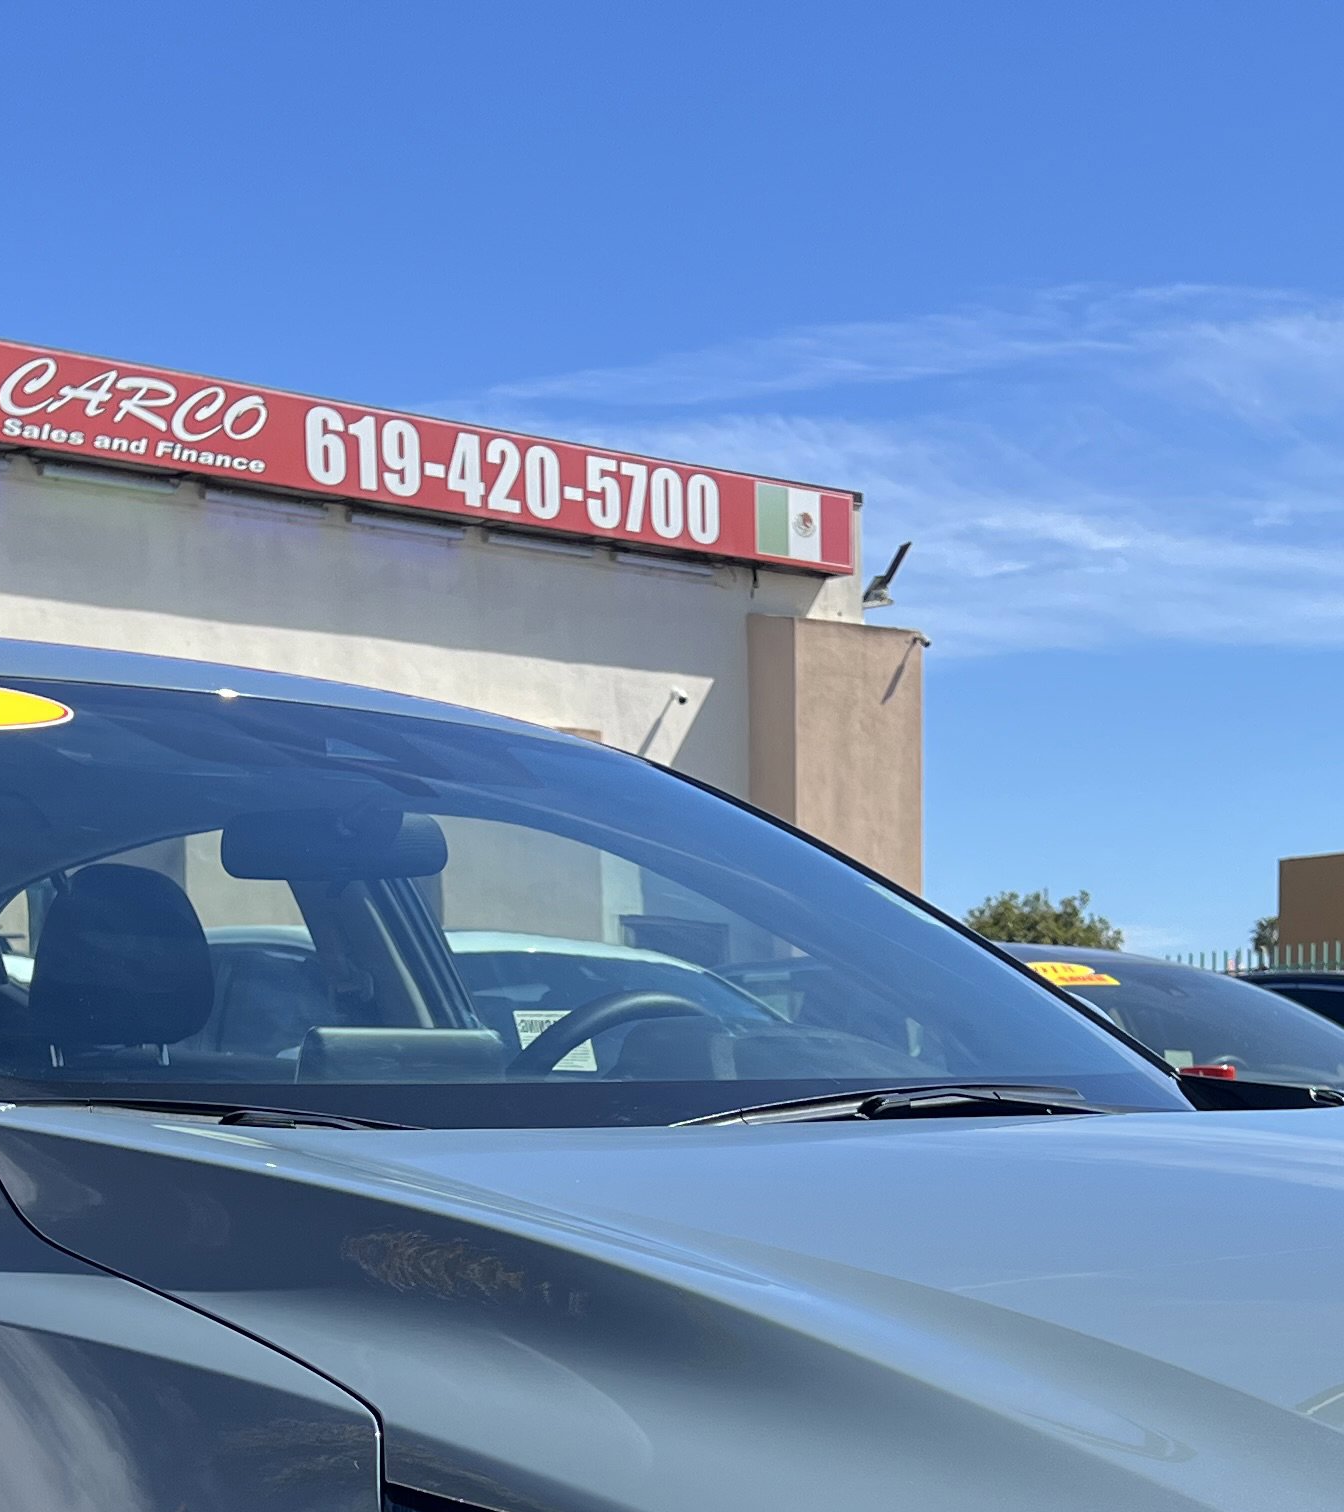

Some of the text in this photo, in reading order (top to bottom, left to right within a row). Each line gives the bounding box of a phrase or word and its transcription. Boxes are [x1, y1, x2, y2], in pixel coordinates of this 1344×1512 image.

[2, 418, 266, 473] Sales and Finance
[304, 406, 720, 545] 619-420-5700
